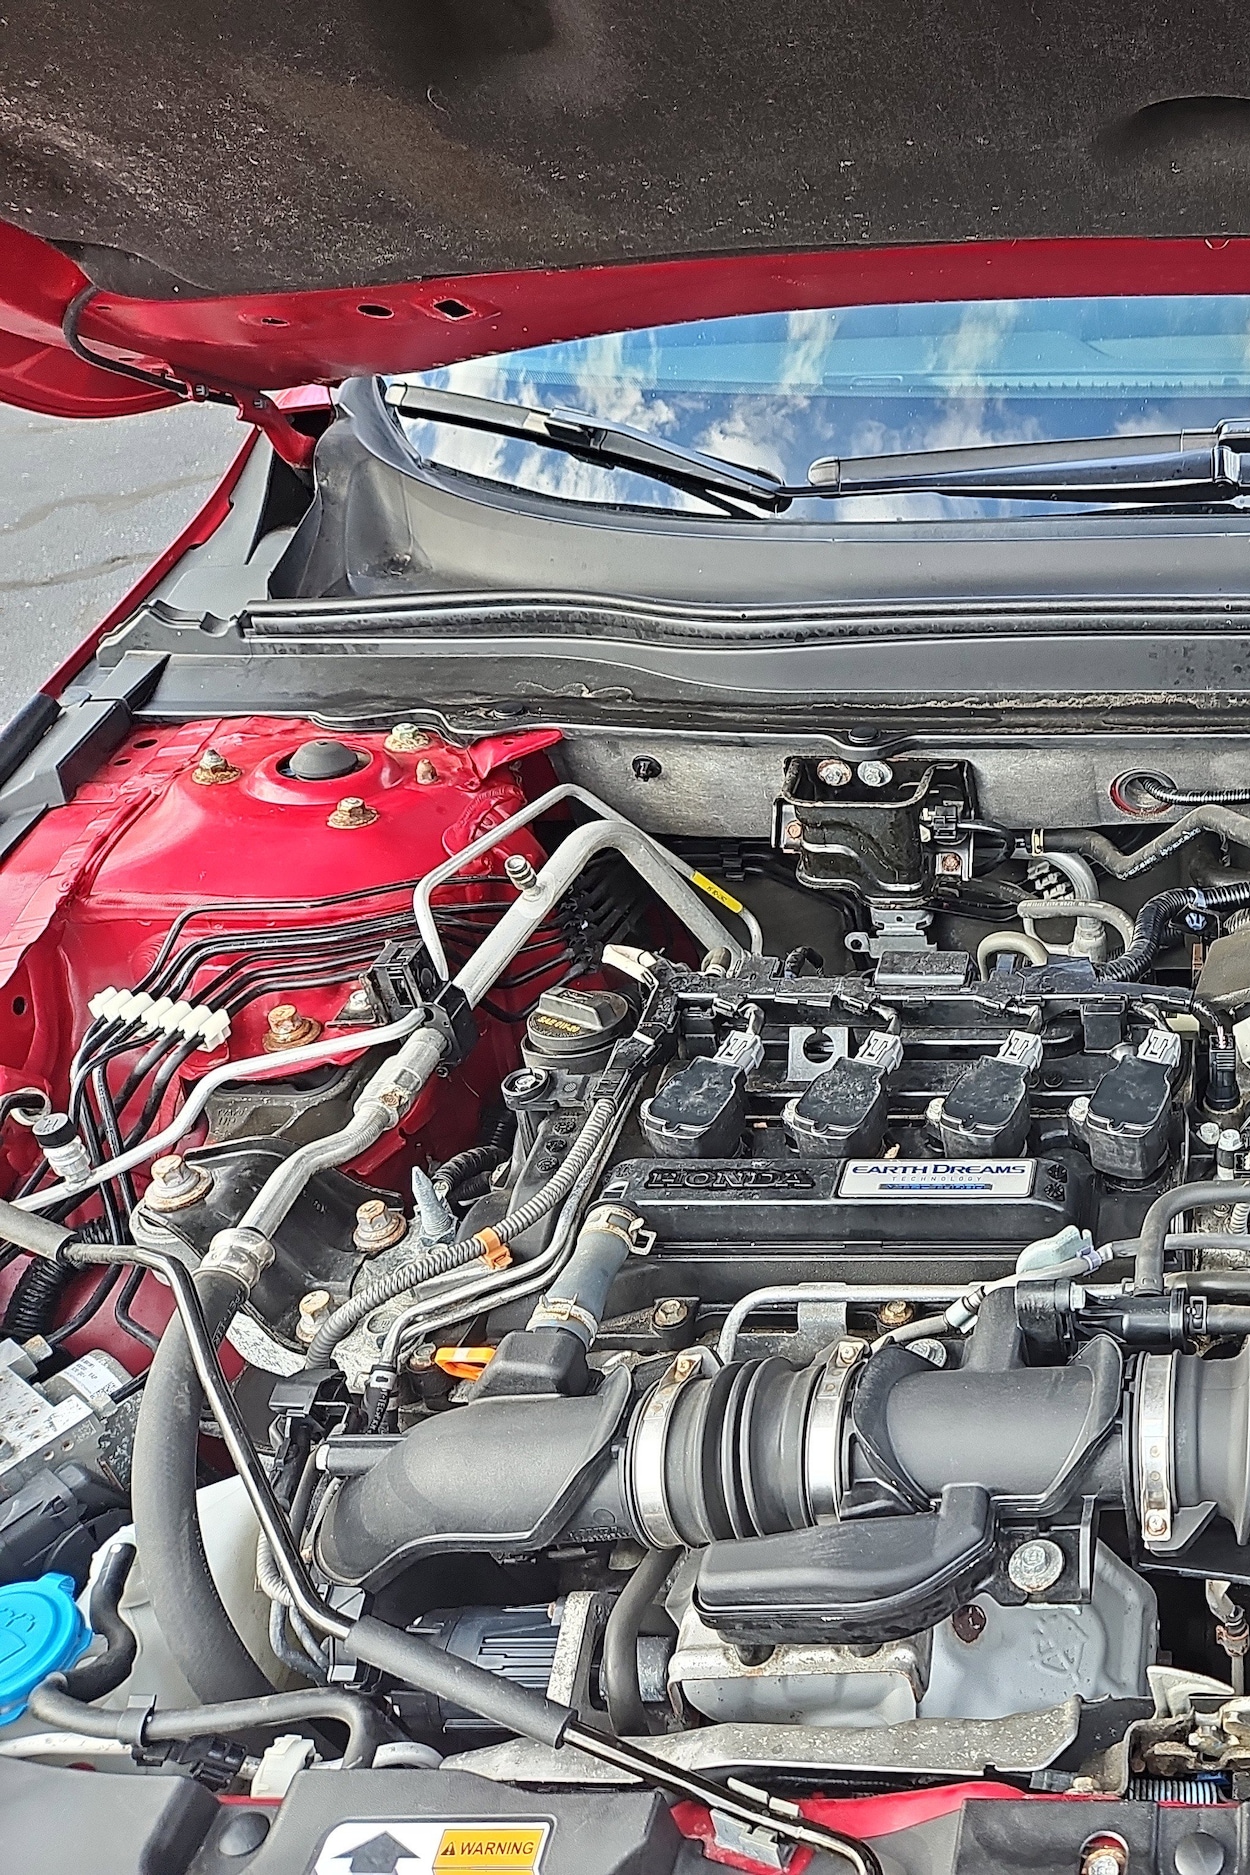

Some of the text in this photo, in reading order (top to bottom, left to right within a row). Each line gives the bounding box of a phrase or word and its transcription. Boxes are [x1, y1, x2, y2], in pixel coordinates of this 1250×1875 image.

[852, 1163, 1026, 1174] EARTH DREAMS
[645, 1170, 814, 1189] HONDA
[459, 1841, 535, 1856] WARNING
